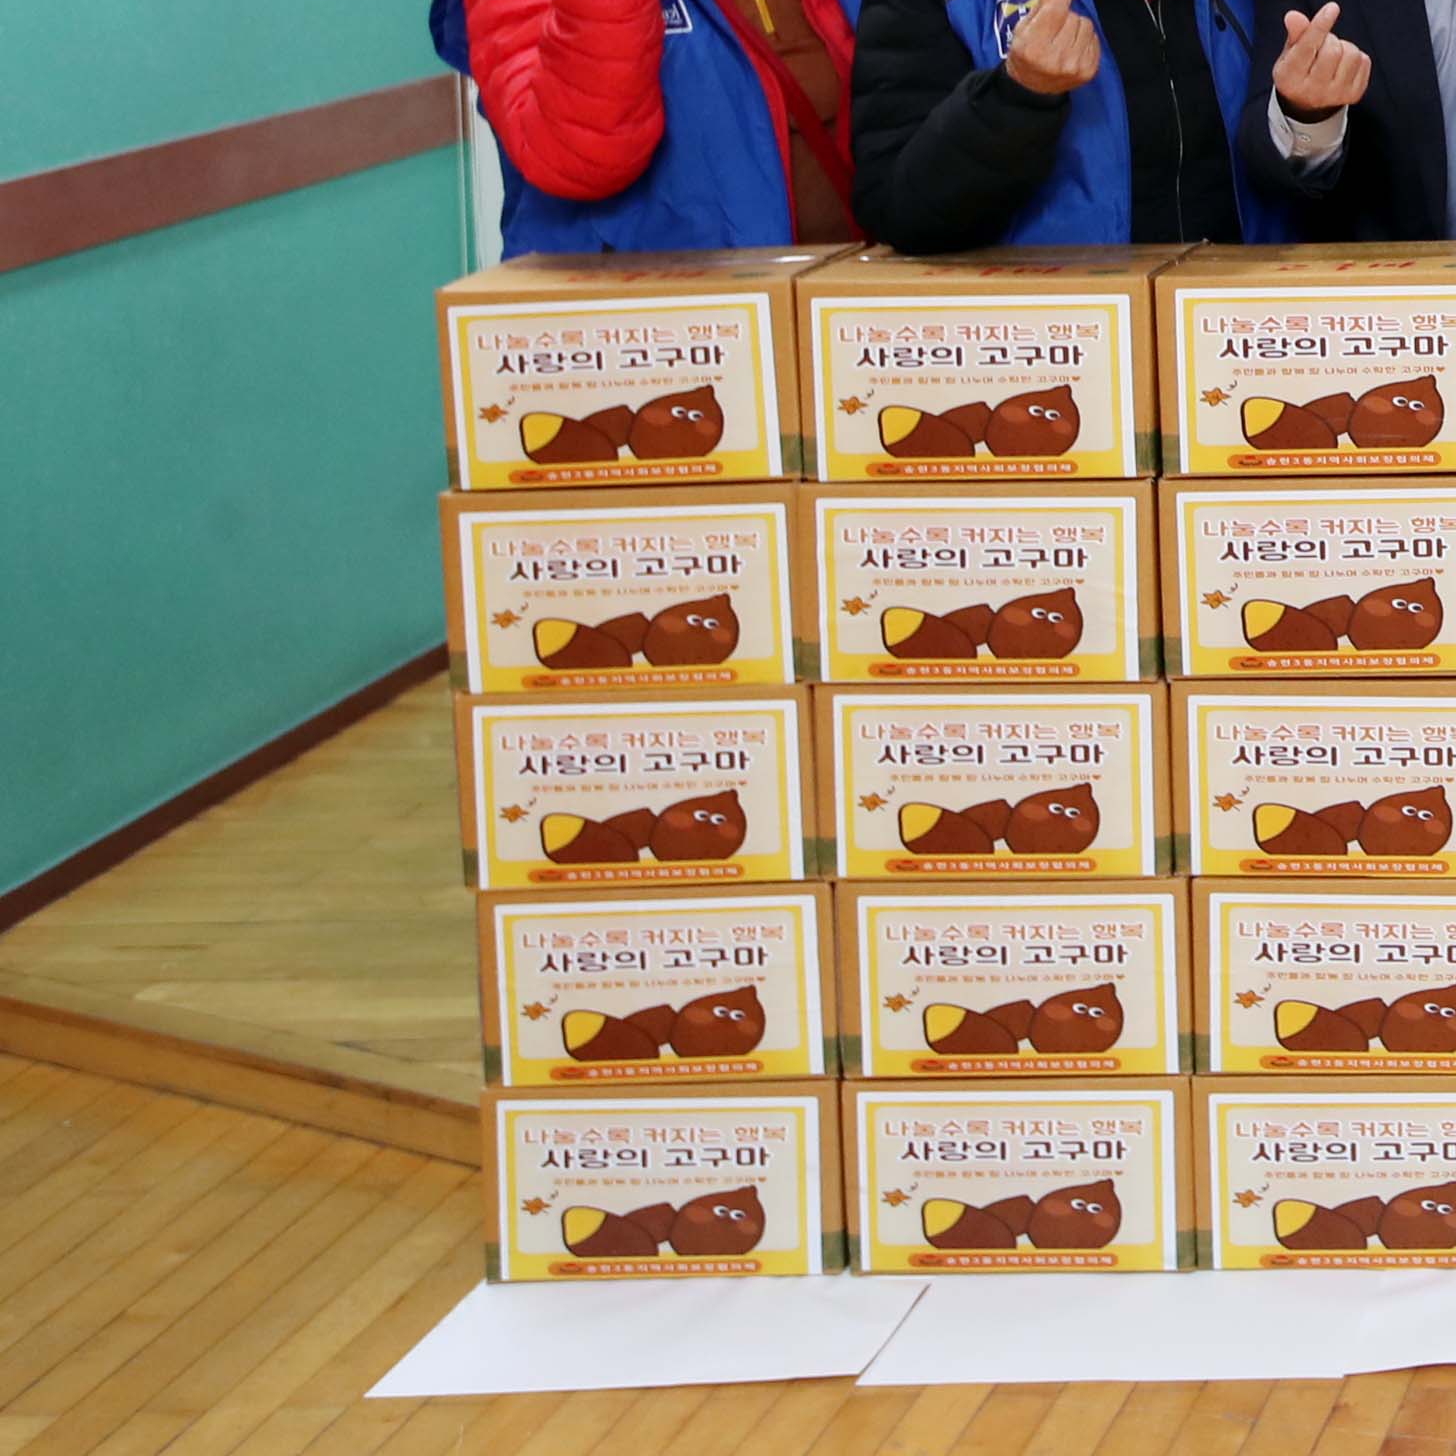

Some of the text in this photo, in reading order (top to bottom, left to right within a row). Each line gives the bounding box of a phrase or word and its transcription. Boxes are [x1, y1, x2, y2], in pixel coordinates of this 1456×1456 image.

[477, 323, 741, 351] 나눌수록 커지는 행복
[1219, 335, 1449, 359] 사랑의 고구마
[494, 344, 726, 375] 사랑의 고구마
[855, 345, 1084, 367] 사랑의 고구마
[859, 547, 1088, 569] 사랑의 고구마
[1219, 538, 1448, 562] 사랑의 고구마
[508, 554, 743, 581] 사랑의 고구마
[517, 750, 751, 775] 사랑의 고구마
[877, 744, 1105, 765] 사랑의 고구마
[1231, 745, 1338, 766] 사랑의
[538, 946, 769, 973] 사랑의 고구마
[901, 944, 1128, 966] 사랑의 고구마
[1254, 941, 1361, 964] 사랑의
[540, 1147, 771, 1169] 사랑의 고구마
[900, 1140, 1127, 1161] 사랑의 고구마
[1251, 1142, 1357, 1162] 사랑의
